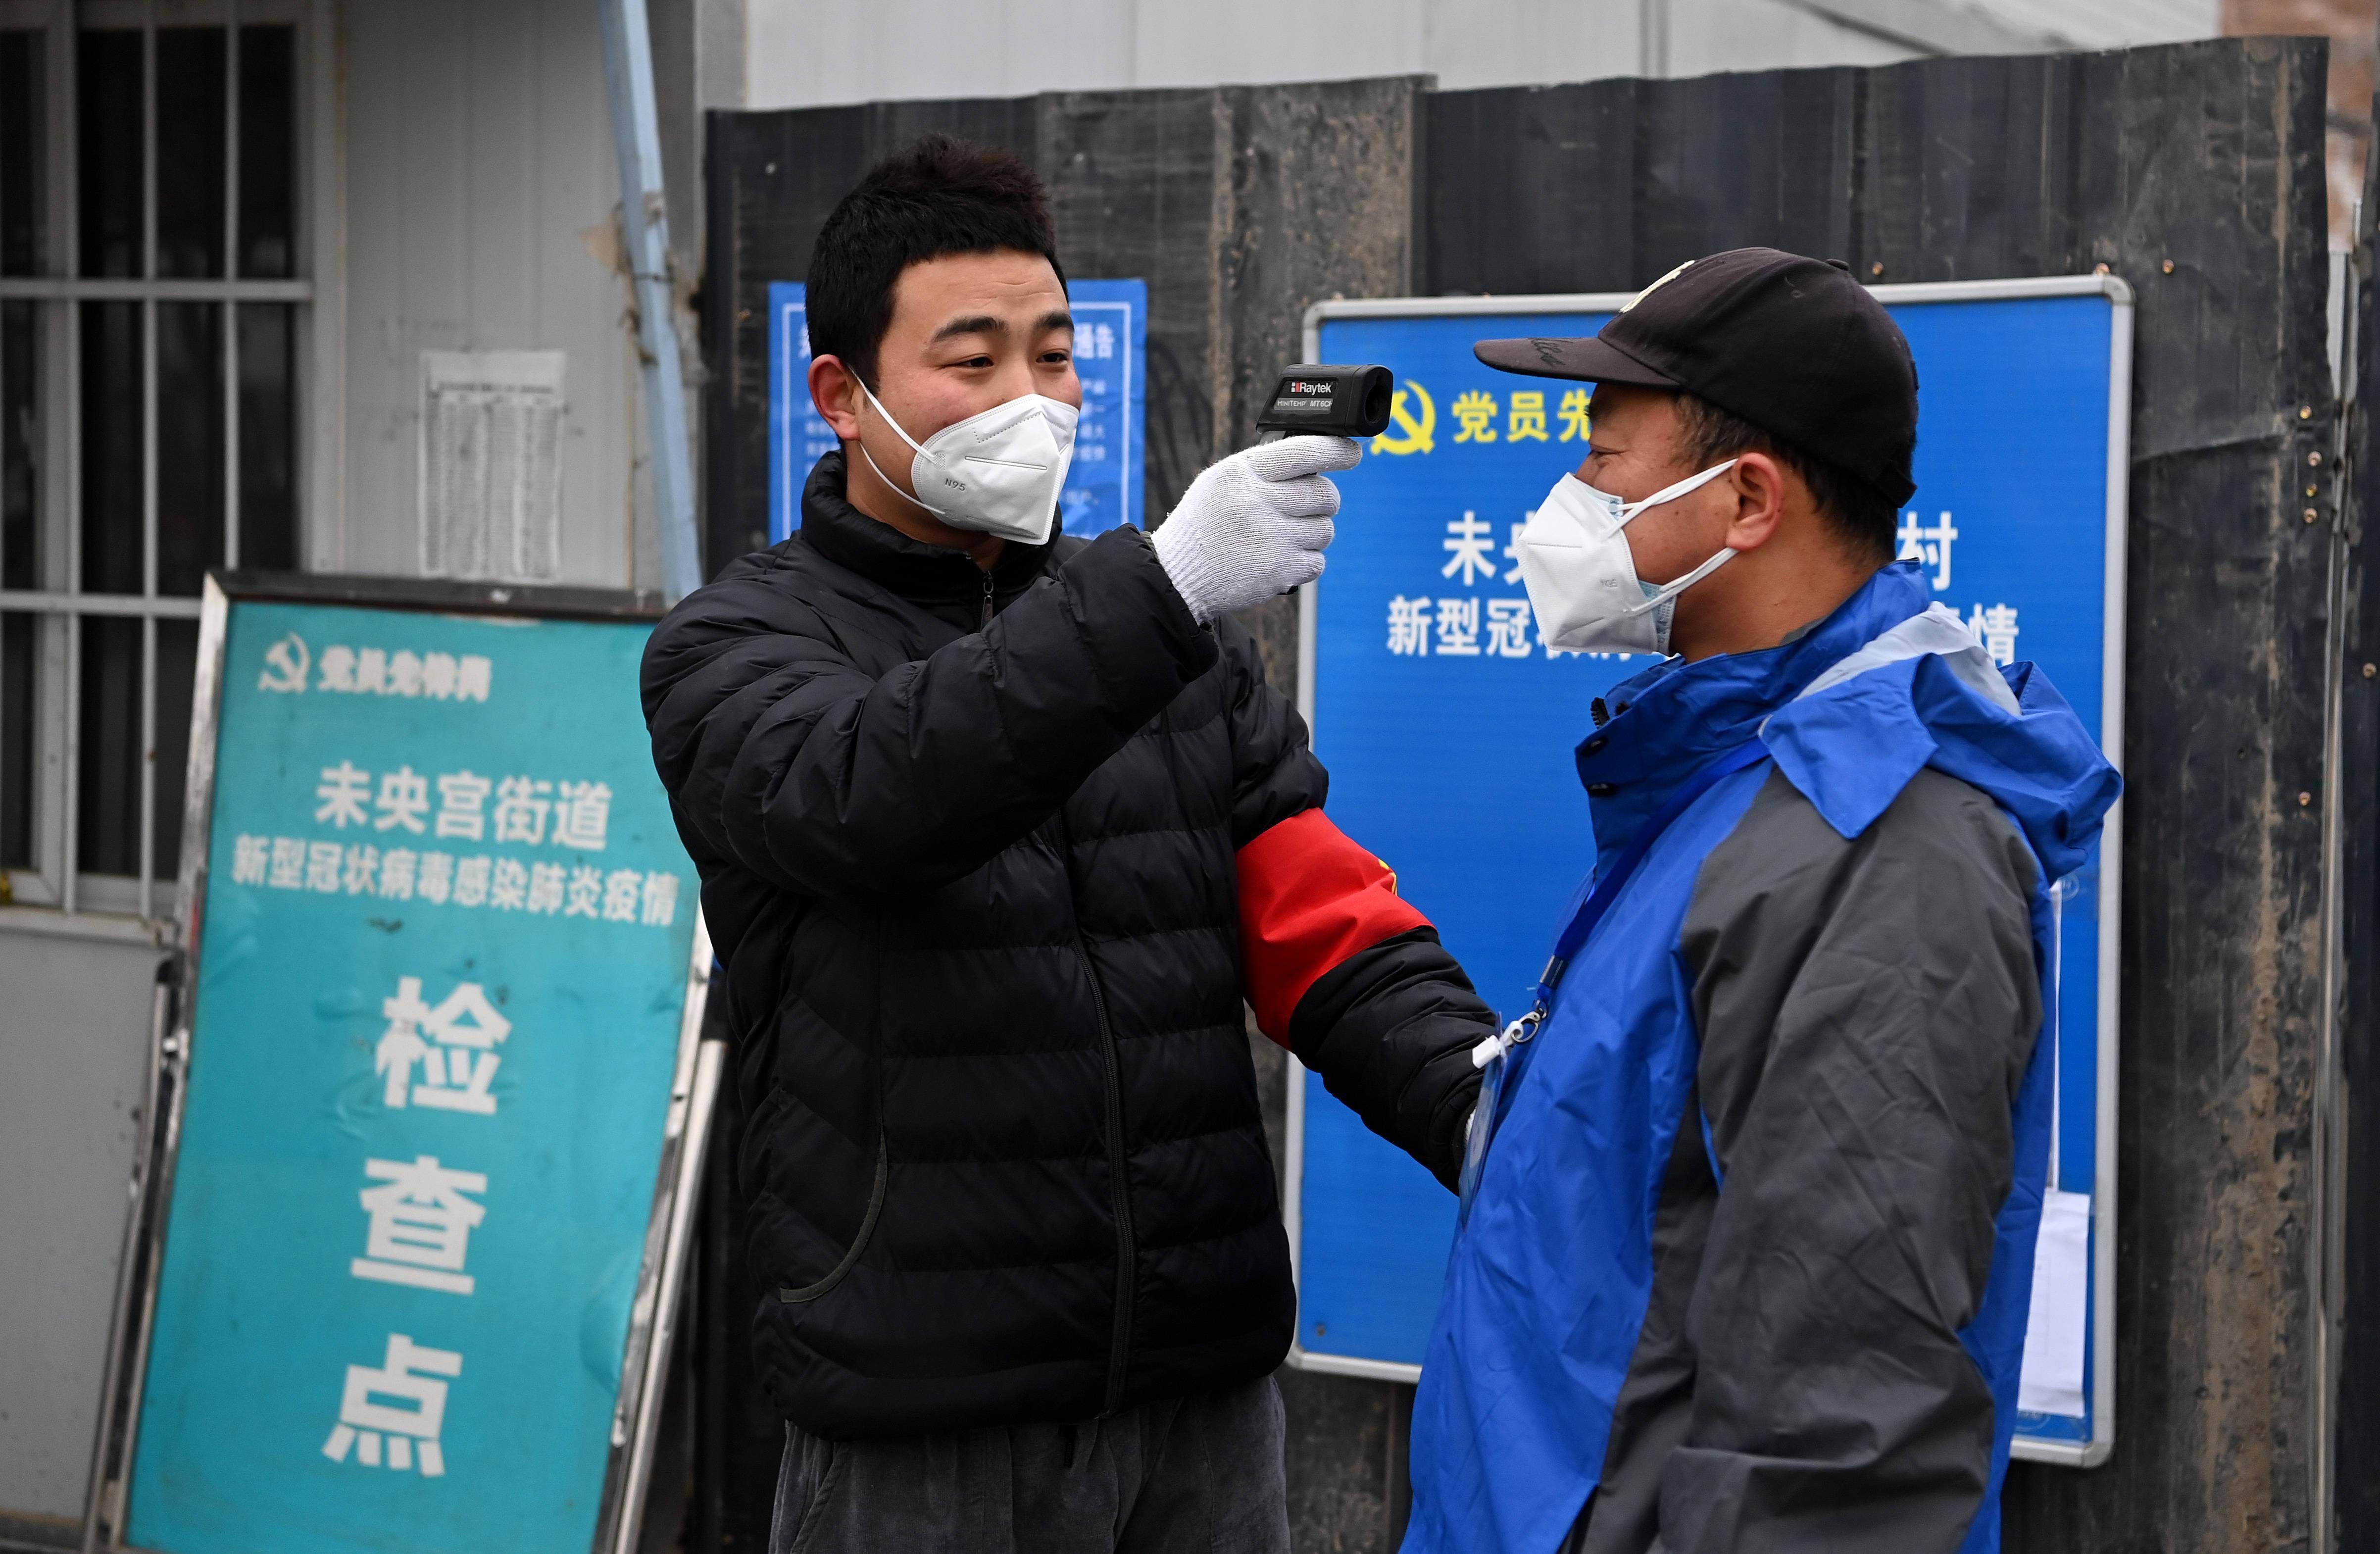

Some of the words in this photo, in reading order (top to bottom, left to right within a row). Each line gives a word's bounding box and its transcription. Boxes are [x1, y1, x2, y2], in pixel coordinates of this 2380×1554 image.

[1299, 382, 1332, 396] Raytek
[1452, 389, 1591, 442] 党员先
[945, 478, 966, 491] N95
[1897, 511, 1958, 590] 村
[1950, 603, 2019, 664] 情
[315, 761, 612, 851] 未央宫街道
[232, 834, 680, 927] 新型冠状病毒感染肺炎疫情
[324, 976, 512, 1476] 检查点
